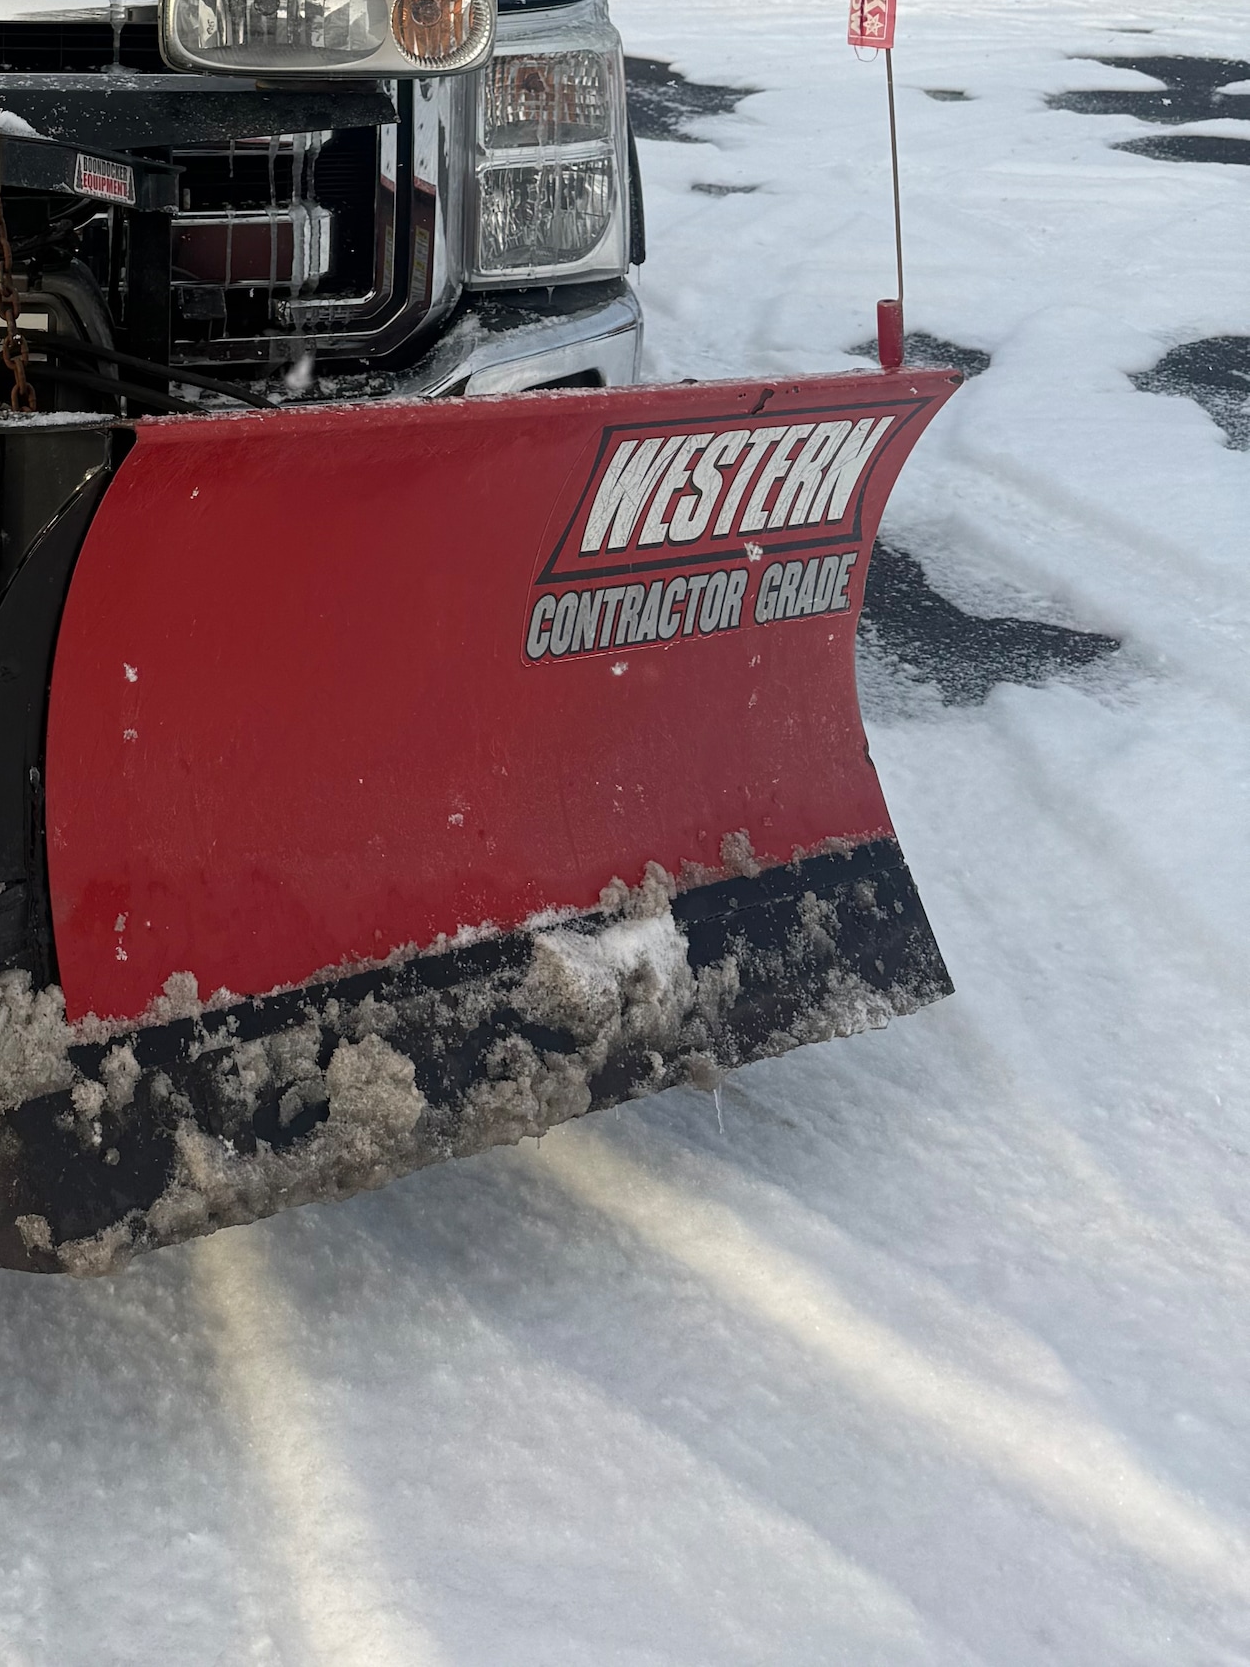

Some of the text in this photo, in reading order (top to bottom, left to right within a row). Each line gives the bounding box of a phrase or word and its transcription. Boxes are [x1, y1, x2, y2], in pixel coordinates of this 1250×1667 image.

[83, 156, 128, 182] BOONDOCKER
[83, 172, 129, 197] EQUIPMENT
[579, 415, 896, 556] WESTERN
[526, 552, 858, 661] CONTRACTOR GRADE
